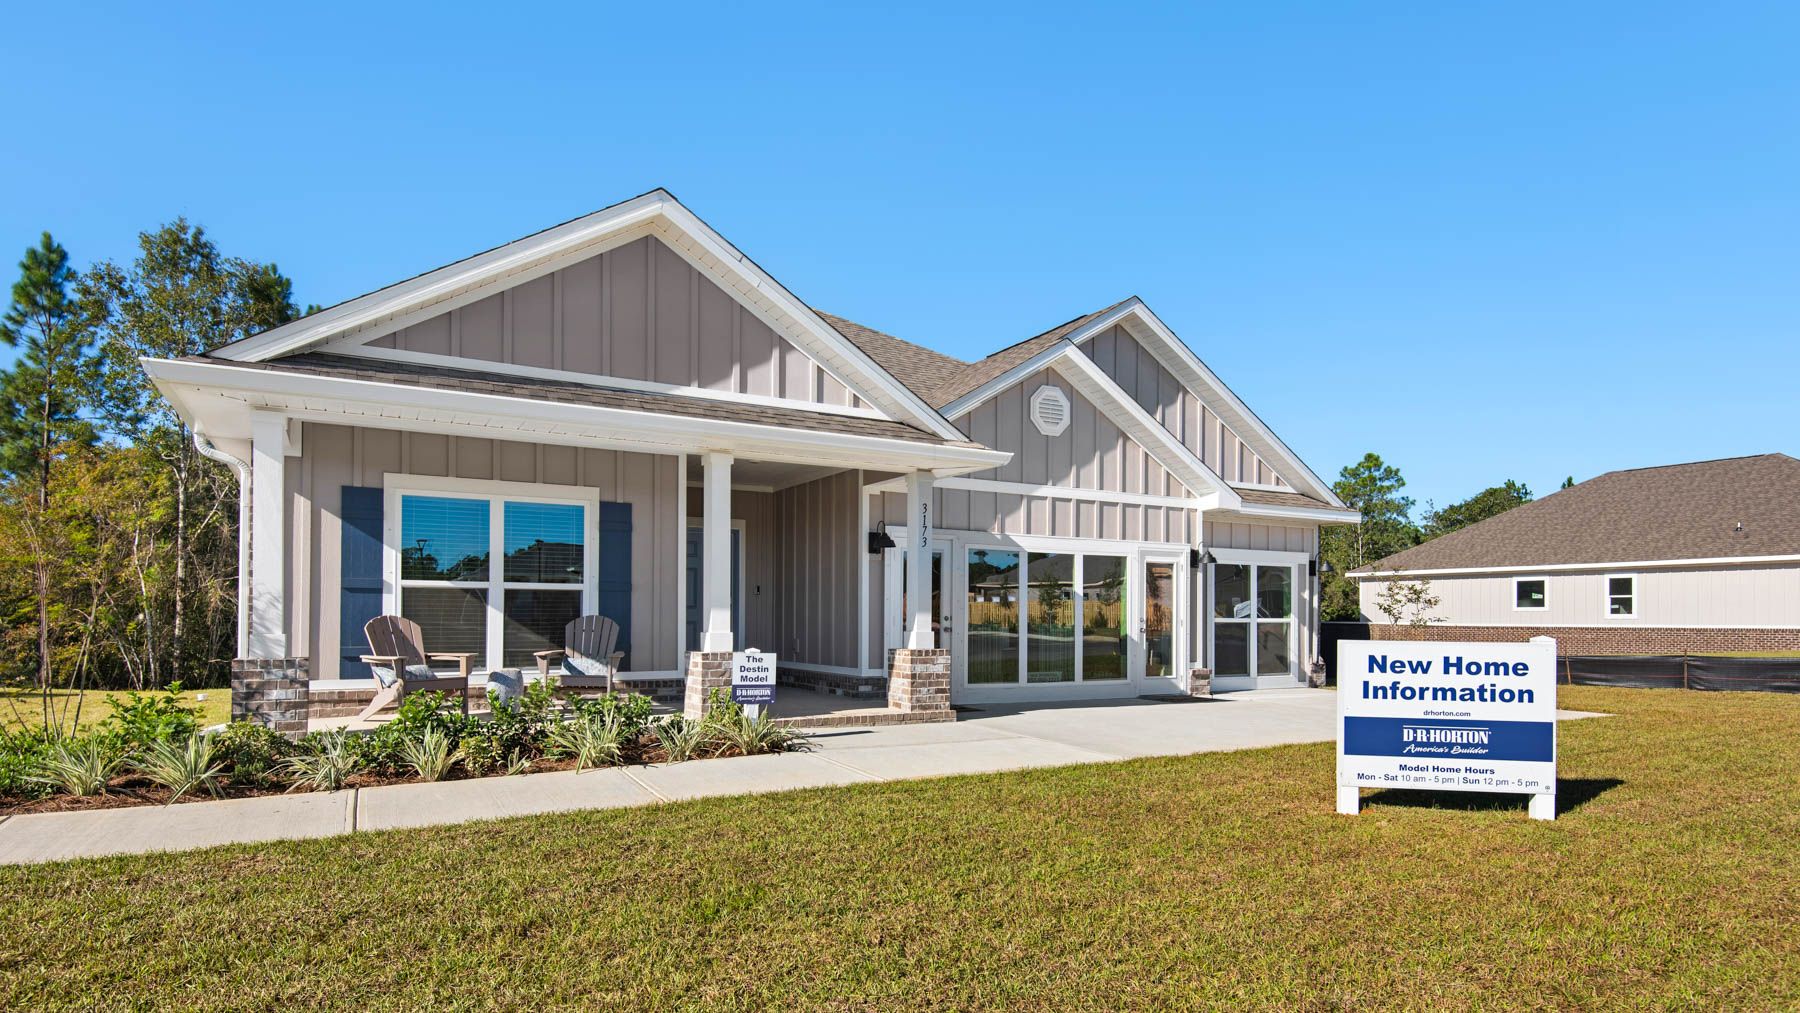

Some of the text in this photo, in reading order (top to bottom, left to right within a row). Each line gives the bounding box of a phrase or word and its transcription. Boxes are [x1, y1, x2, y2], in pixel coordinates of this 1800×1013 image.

[1368, 655, 1529, 676] New Home
[1362, 680, 1534, 703] Information
[1403, 744, 1488, 754] America's Builder
[1399, 764, 1428, 772] Model
[1464, 766, 1495, 774] Hours
[1384, 774, 1398, 782] Sat
[1462, 776, 1480, 784] Sun
